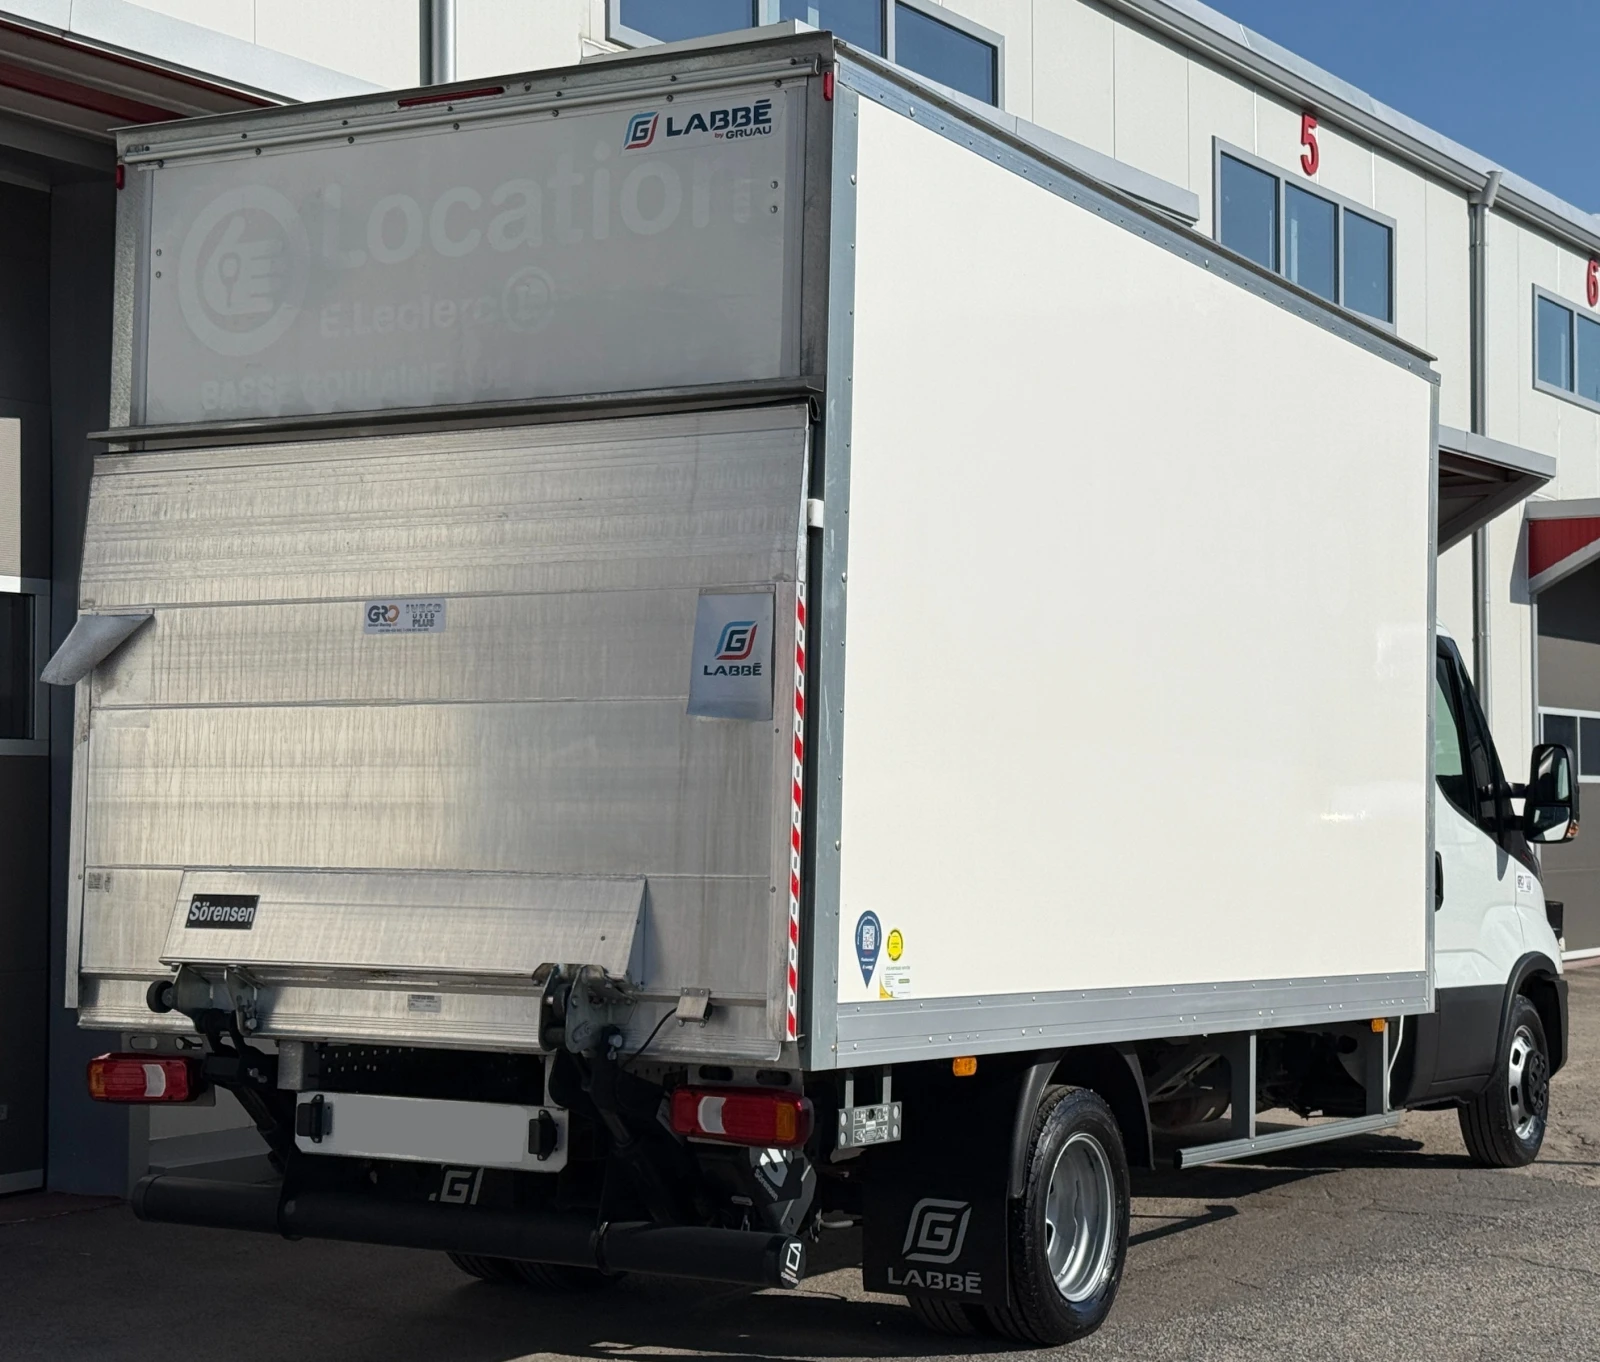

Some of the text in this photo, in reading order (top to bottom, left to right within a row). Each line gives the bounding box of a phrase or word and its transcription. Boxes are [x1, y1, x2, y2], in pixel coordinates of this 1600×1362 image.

[666, 98, 772, 137] LABBÉ
[725, 125, 772, 140] GRUAU
[1300, 111, 1320, 177] 5
[322, 138, 752, 272] Location
[1587, 258, 1599, 308] 6
[367, 604, 400, 623] GRO
[412, 618, 435, 628] PLUS
[703, 662, 762, 676] LABBÉ
[189, 901, 255, 923] Sörensen
[887, 1266, 982, 1294] LABBÉ
